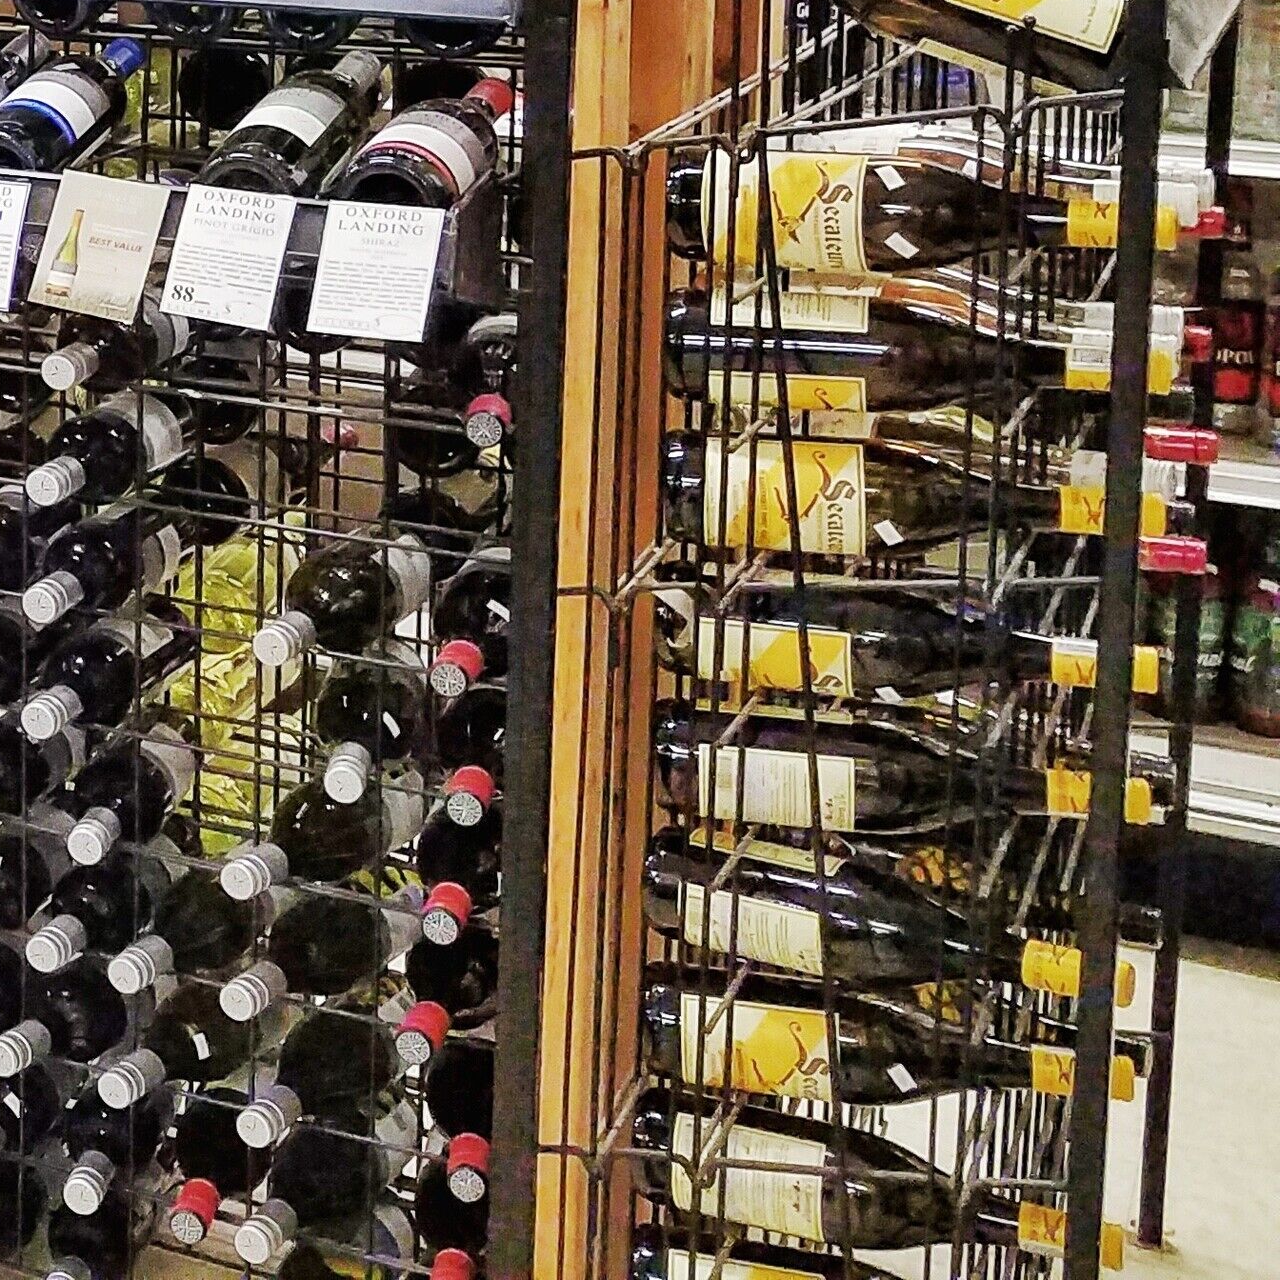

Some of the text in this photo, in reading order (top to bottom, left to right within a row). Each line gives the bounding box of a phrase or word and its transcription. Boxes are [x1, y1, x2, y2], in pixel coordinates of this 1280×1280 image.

[204, 190, 275, 209] OXFORD
[196, 203, 276, 223] LANDING
[346, 206, 422, 222] OXFORD
[338, 219, 424, 236] LANDING
[90, 236, 113, 250] BEST
[171, 283, 195, 303] 88
